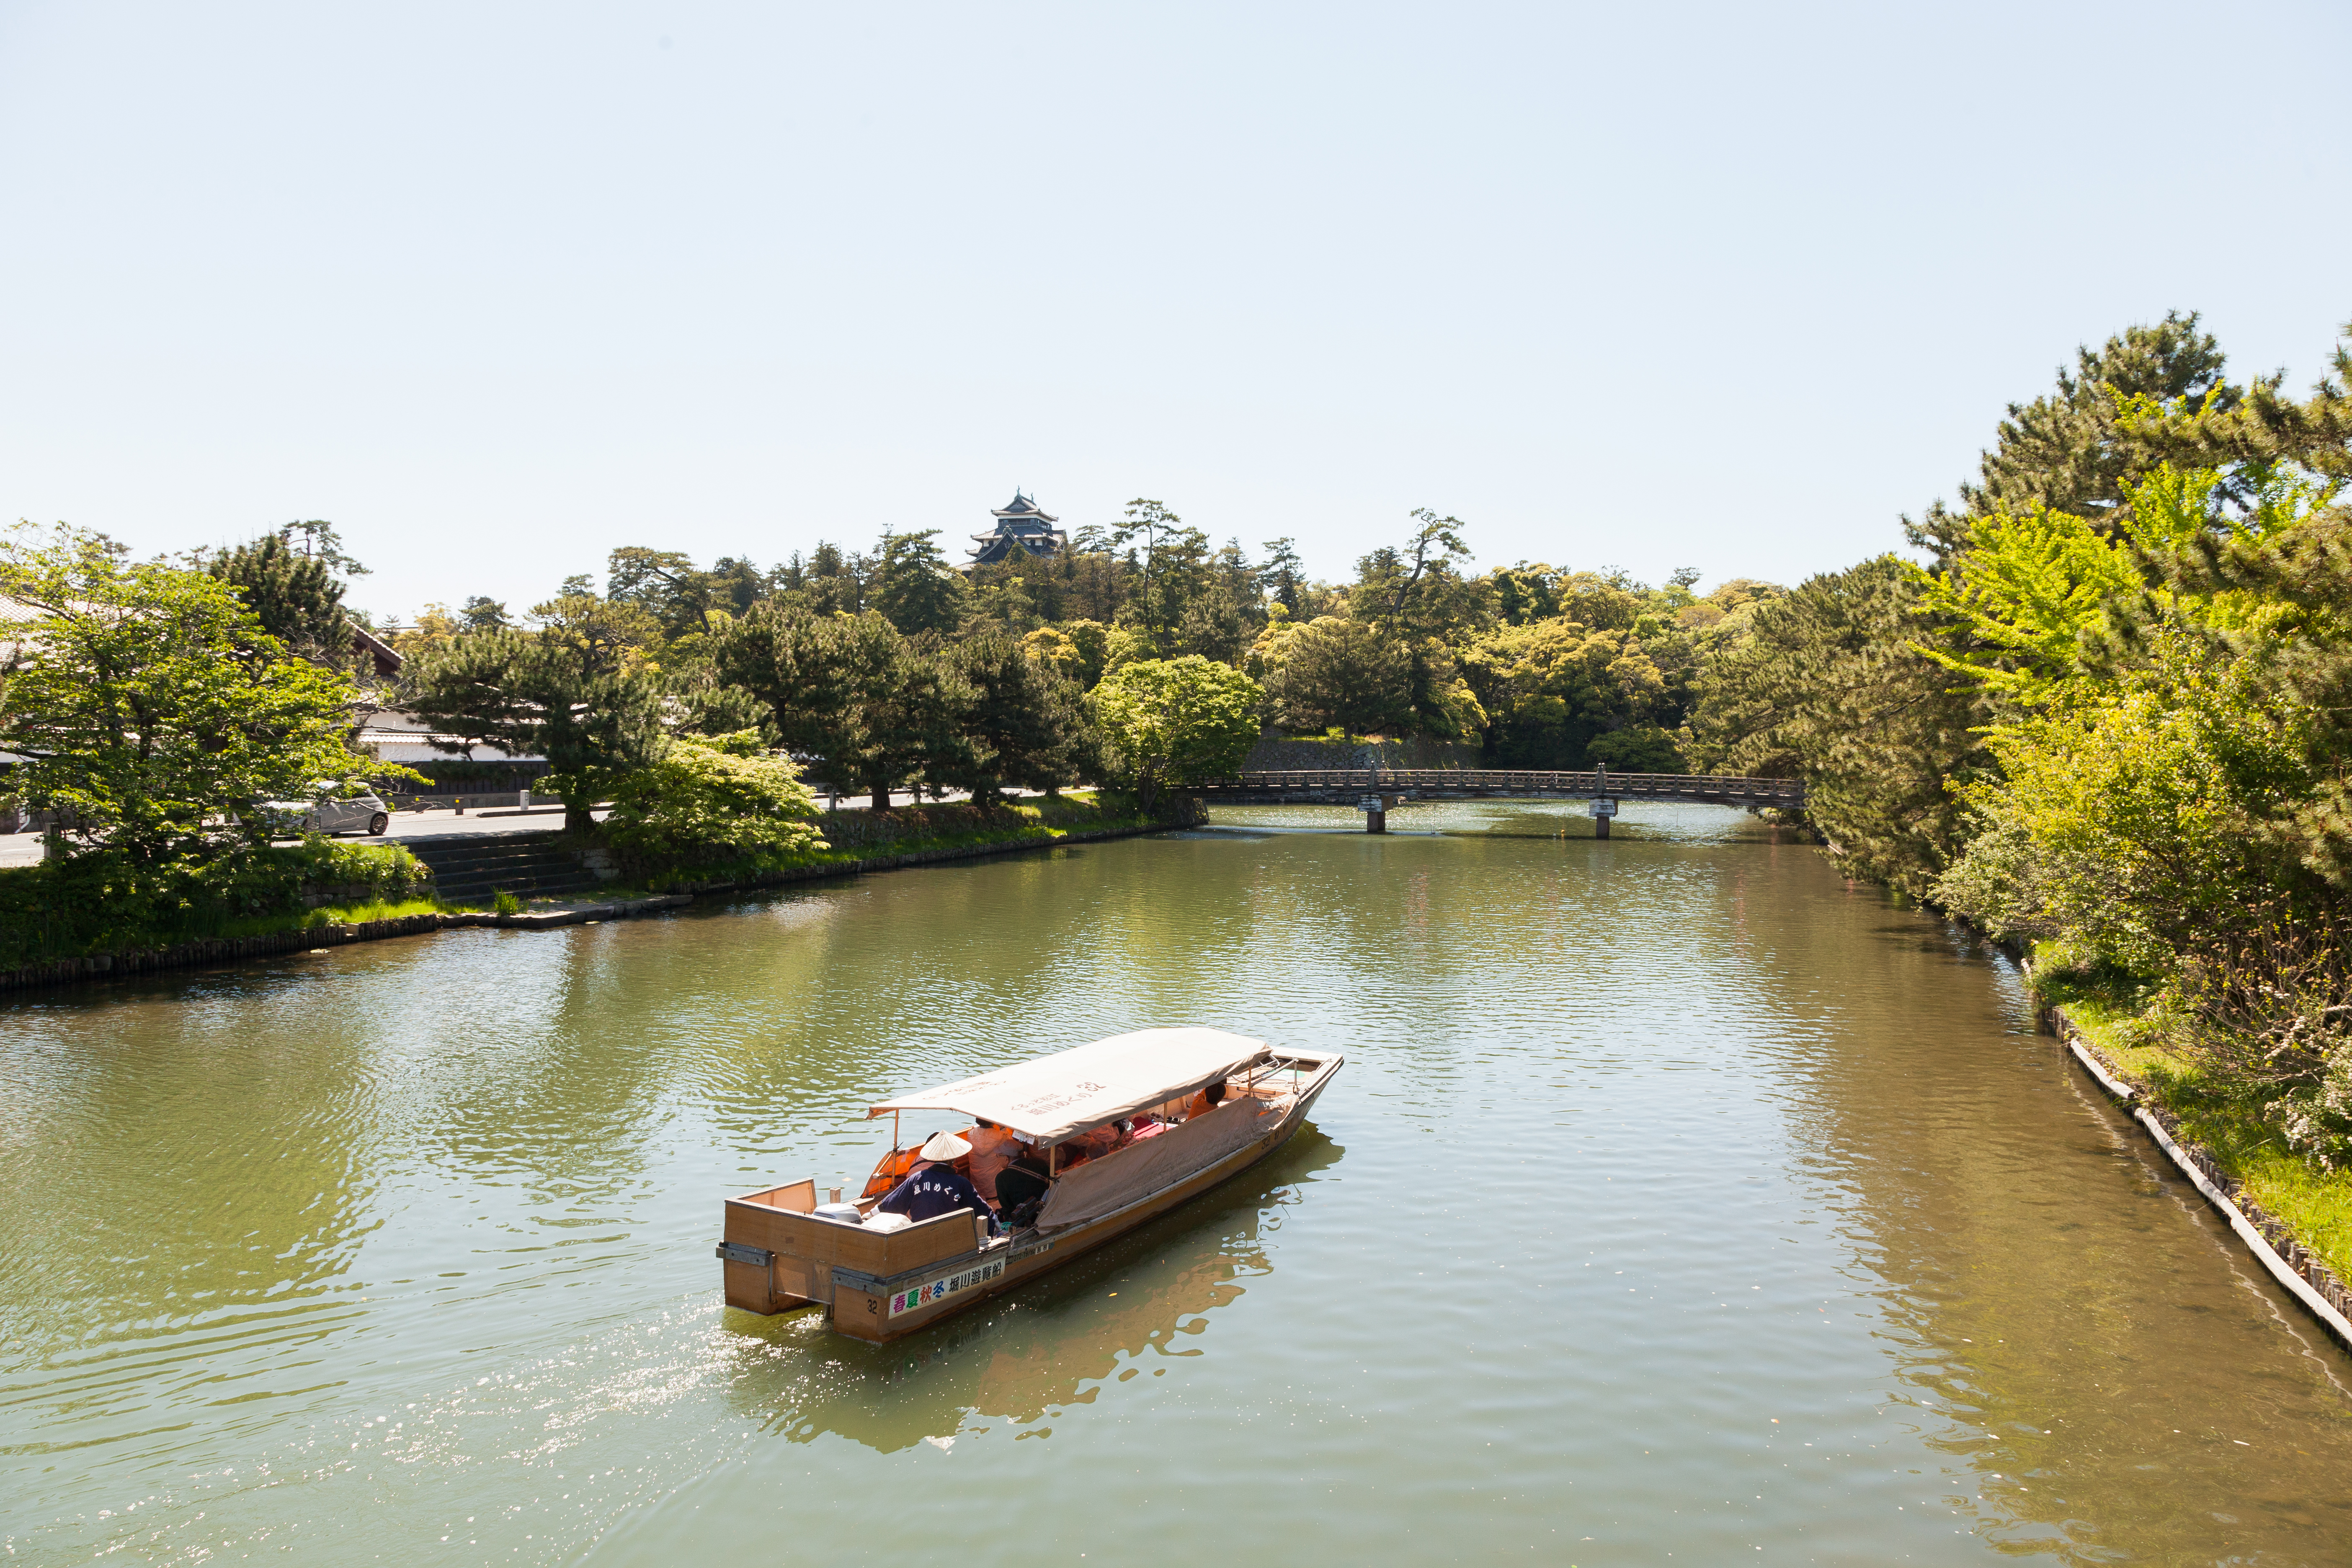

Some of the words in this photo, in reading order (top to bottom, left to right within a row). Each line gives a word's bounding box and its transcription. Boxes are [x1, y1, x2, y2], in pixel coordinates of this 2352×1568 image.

[1011, 1093, 1061, 1110] ぐるっと松江
[1026, 1092, 1092, 1115] 堀川めぐり
[1076, 1082, 1107, 1091] 32
[1261, 1135, 1270, 1150] 32
[893, 1280, 944, 1313] 春夏秋冬
[949, 1261, 1001, 1292] 堀川遊覧船
[867, 1298, 877, 1315] 32
